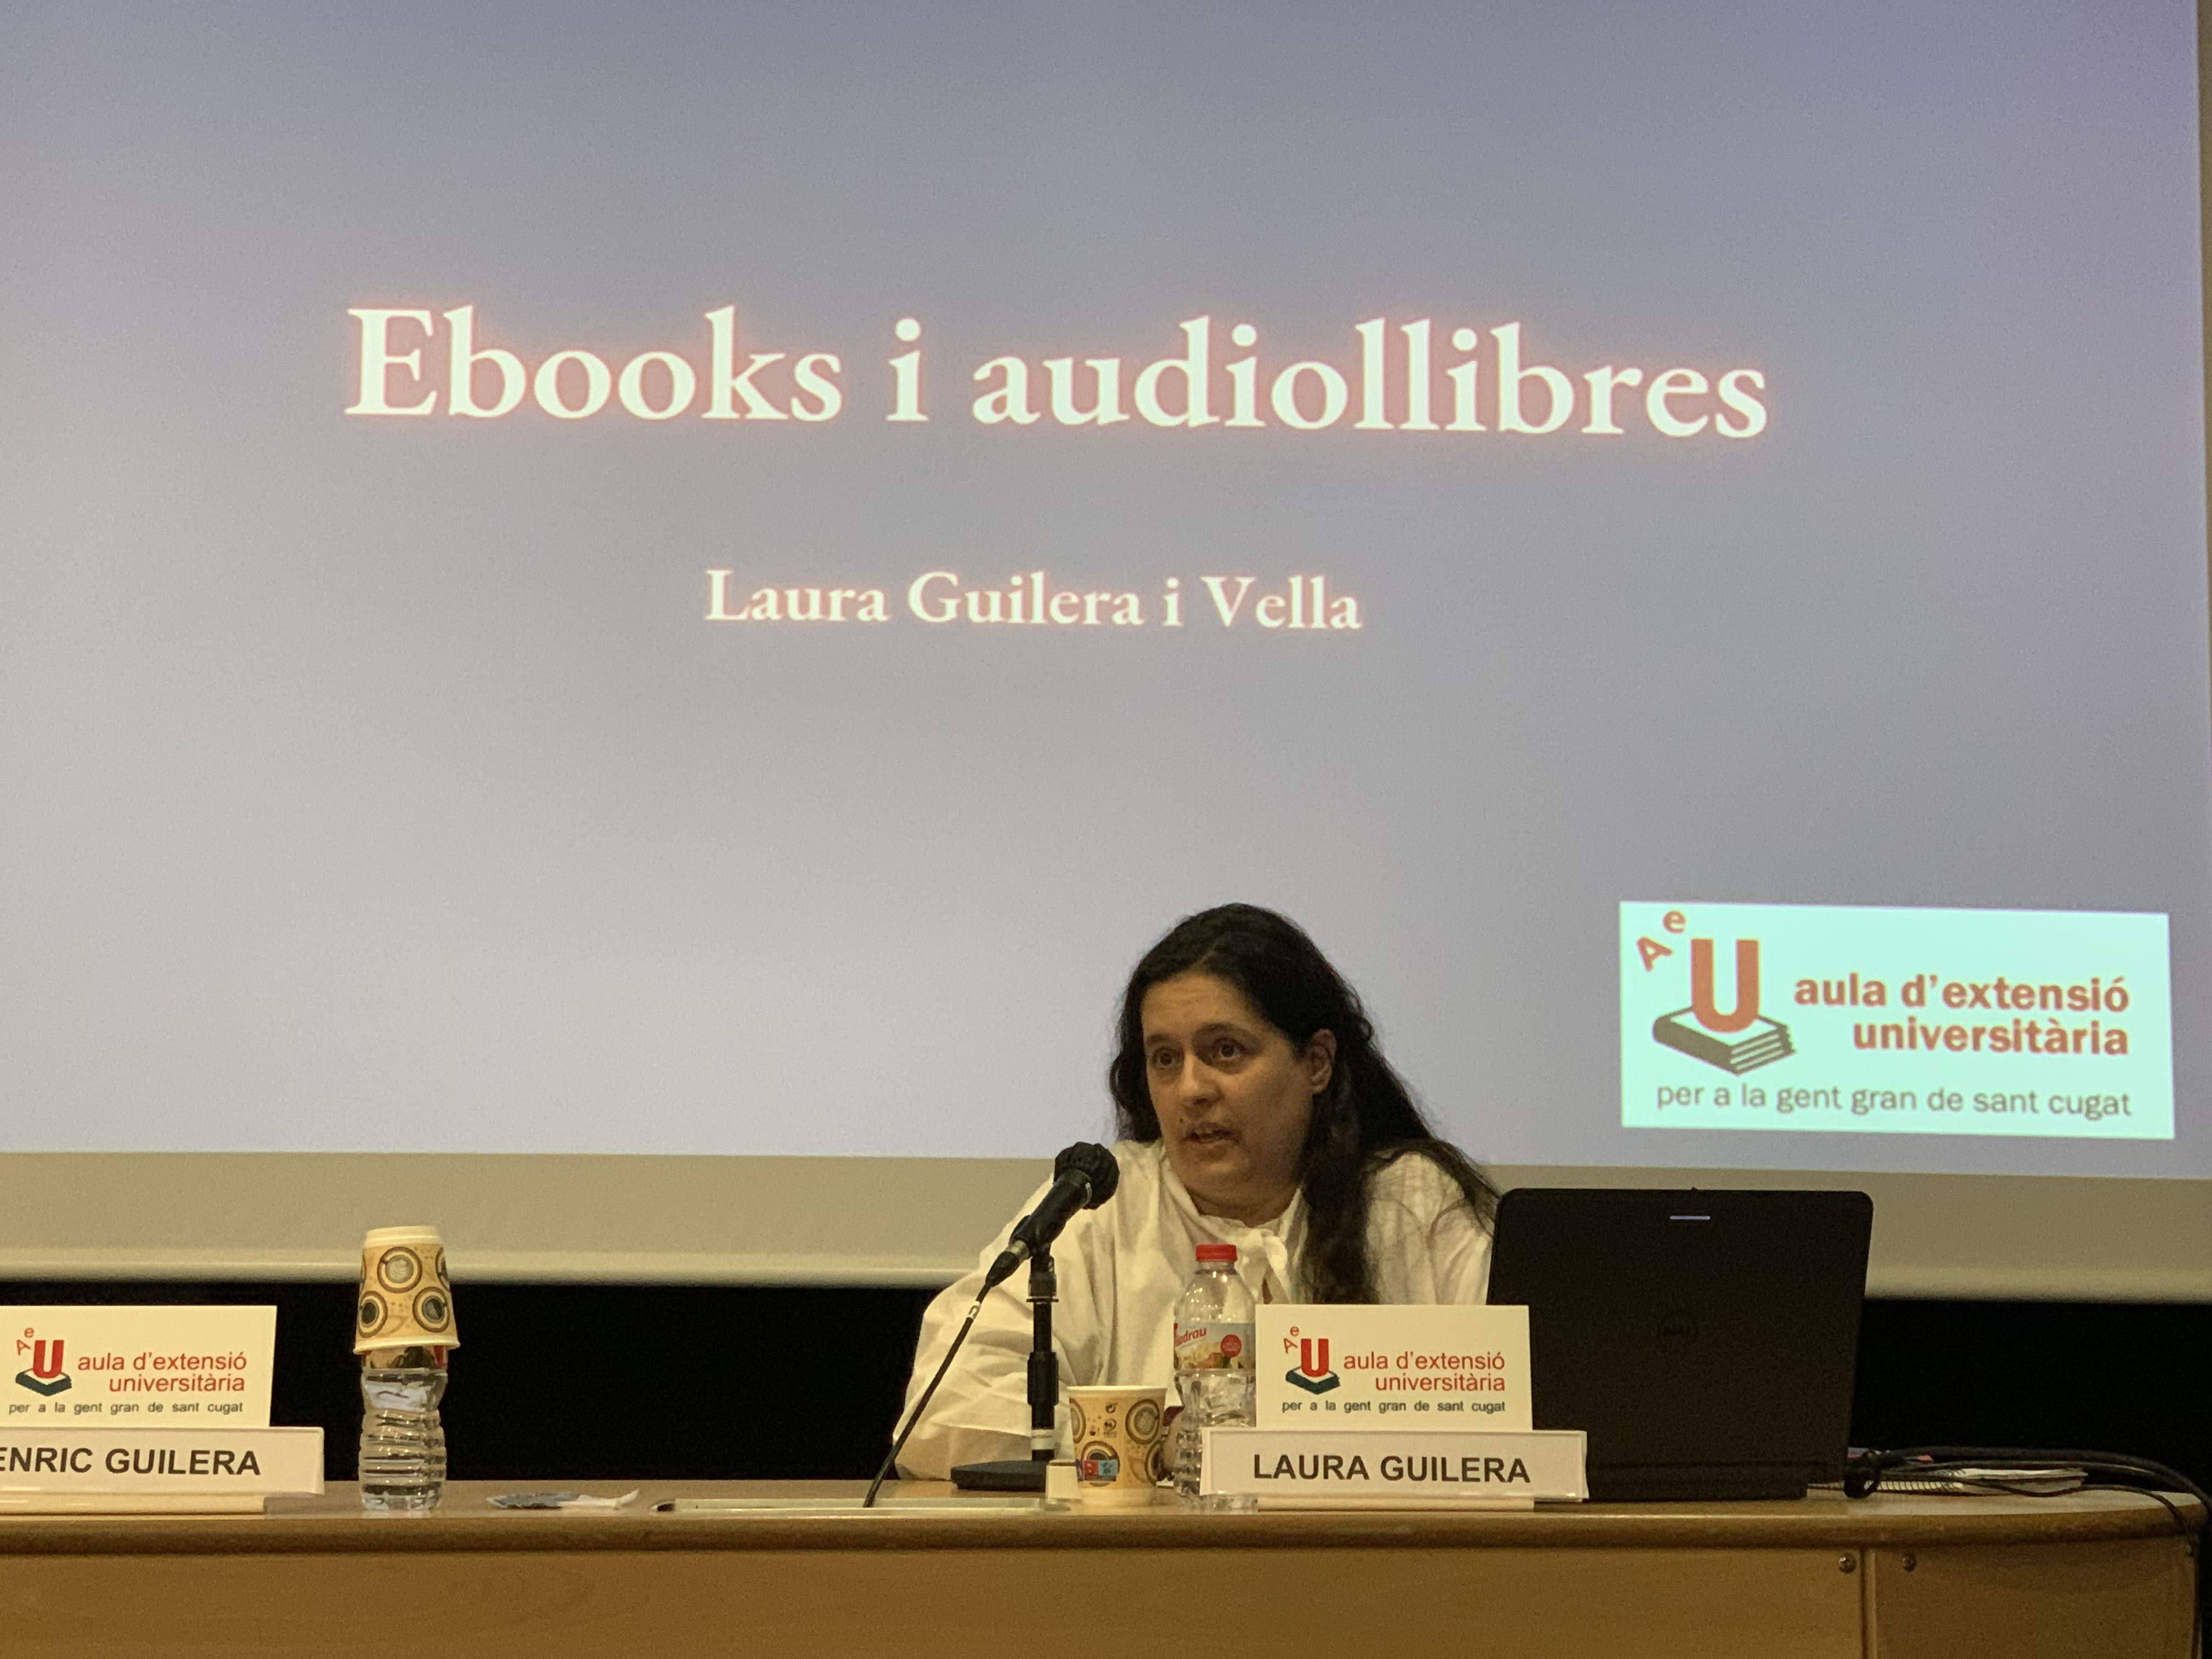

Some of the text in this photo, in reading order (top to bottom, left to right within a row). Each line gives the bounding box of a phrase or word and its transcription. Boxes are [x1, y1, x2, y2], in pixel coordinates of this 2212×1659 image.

[345, 306, 1766, 438] Ebooks i audiollibres
[706, 570, 1362, 629] Laura Guilera i Vella
[1795, 973, 1886, 1007] aula
[1854, 1016, 2128, 1055] universitària
[1657, 1084, 2131, 1121] per a la gent gran de sant cugat
[78, 1353, 124, 1370] aula
[1344, 1351, 1388, 1369] aula
[109, 1374, 244, 1392] universitària
[1376, 1373, 1505, 1391] universitària
[9, 1404, 30, 1414] per
[55, 1402, 65, 1413] la
[74, 1403, 102, 1415] gent
[110, 1404, 139, 1415] gran
[148, 1402, 163, 1412] de
[172, 1403, 199, 1412] sant
[207, 1403, 242, 1415] cugat
[1282, 1401, 1505, 1414] per a la gent gran de sant cugat
[105, 1449, 260, 1475] GUILERA
[1255, 1454, 1530, 1483] LAURA GUILERA
